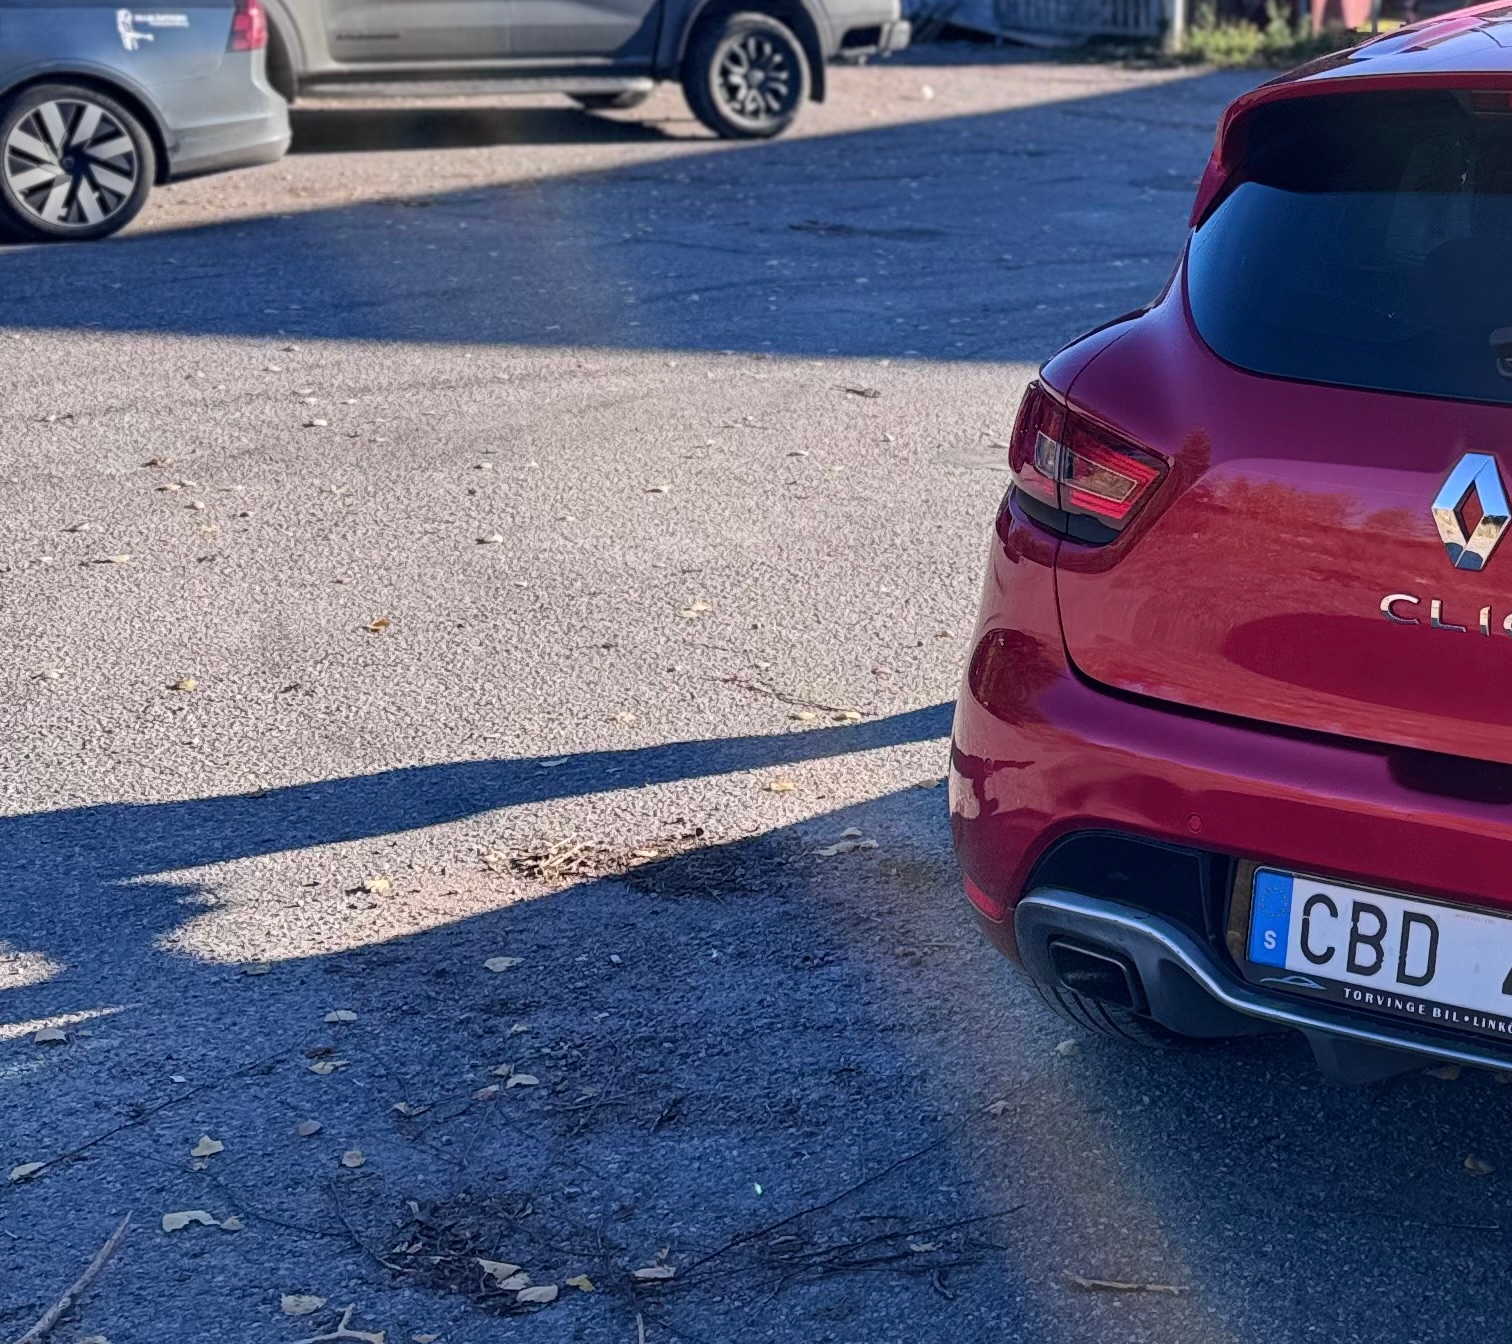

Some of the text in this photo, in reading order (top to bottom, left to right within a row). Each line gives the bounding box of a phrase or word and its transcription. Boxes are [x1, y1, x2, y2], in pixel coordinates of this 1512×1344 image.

[1263, 929, 1277, 950] S
[1300, 893, 1440, 987] CBD
[1343, 987, 1426, 1015] TORVINGE
[1432, 1007, 1460, 1023] BIL
